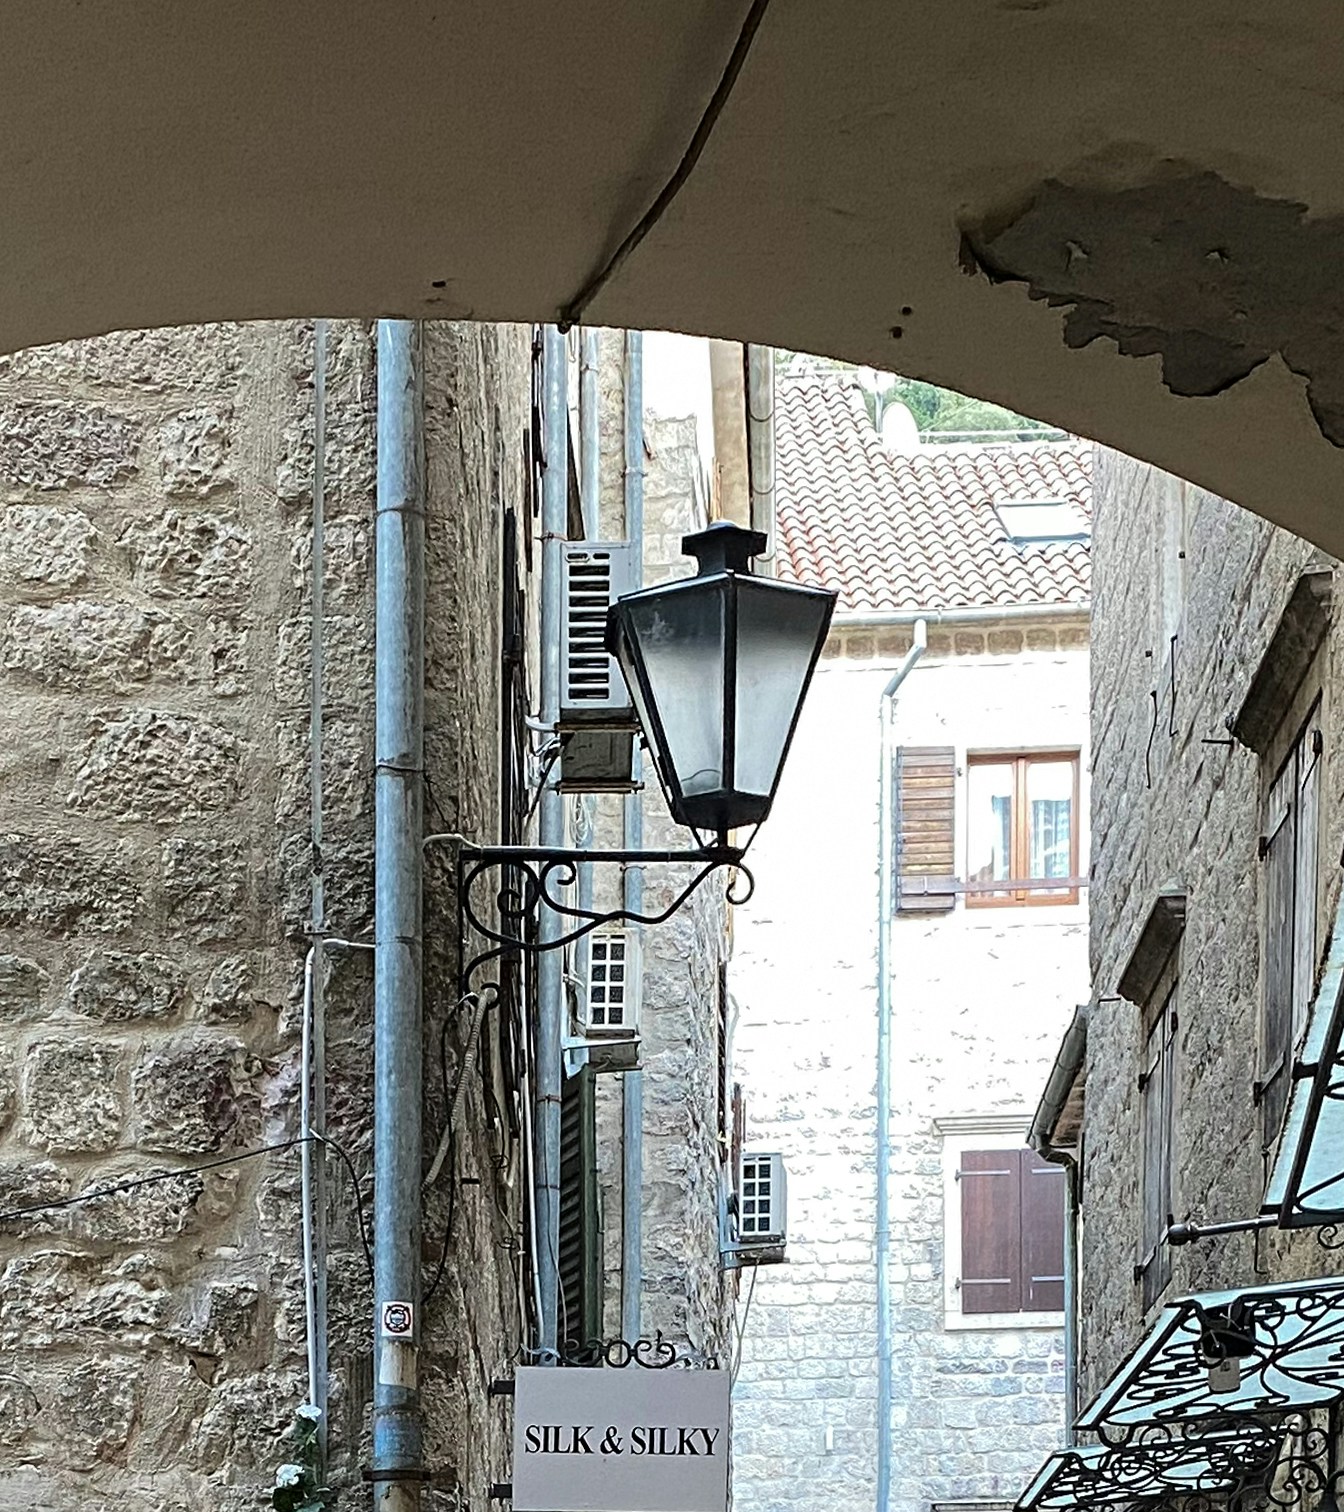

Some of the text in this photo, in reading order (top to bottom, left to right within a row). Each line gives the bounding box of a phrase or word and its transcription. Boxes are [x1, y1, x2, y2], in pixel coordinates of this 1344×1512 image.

[525, 1425, 720, 1456] SILK & SILKY
